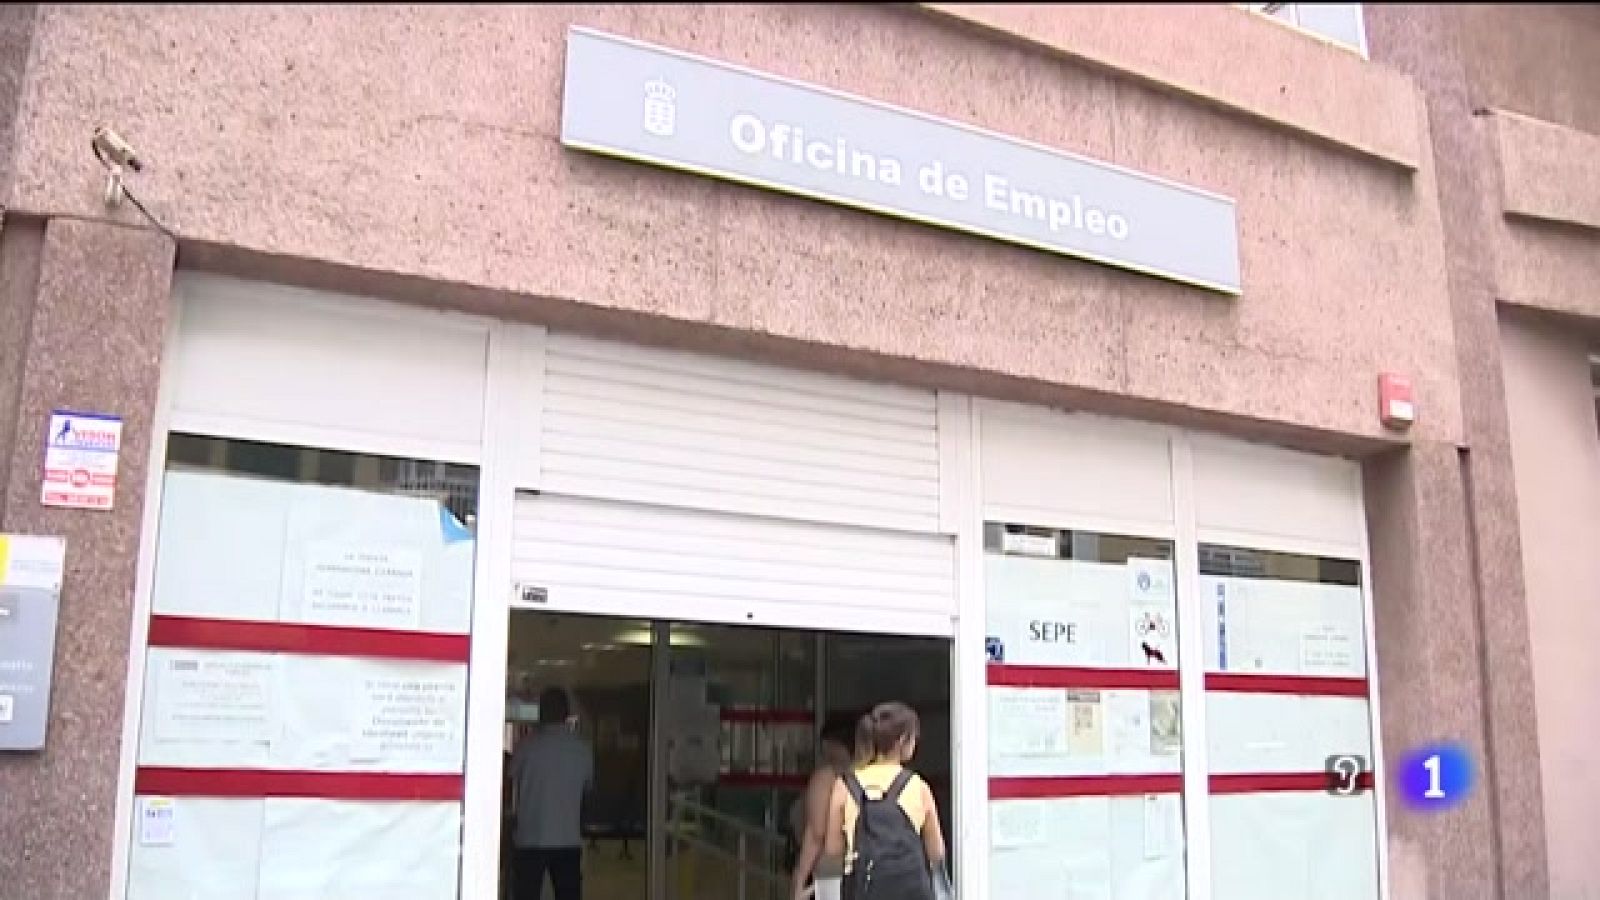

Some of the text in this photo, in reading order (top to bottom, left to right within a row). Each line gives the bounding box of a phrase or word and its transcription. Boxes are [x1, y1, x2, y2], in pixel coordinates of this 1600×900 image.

[730, 114, 1129, 241] Oficina de Empleo
[1029, 619, 1078, 645] SEPE
